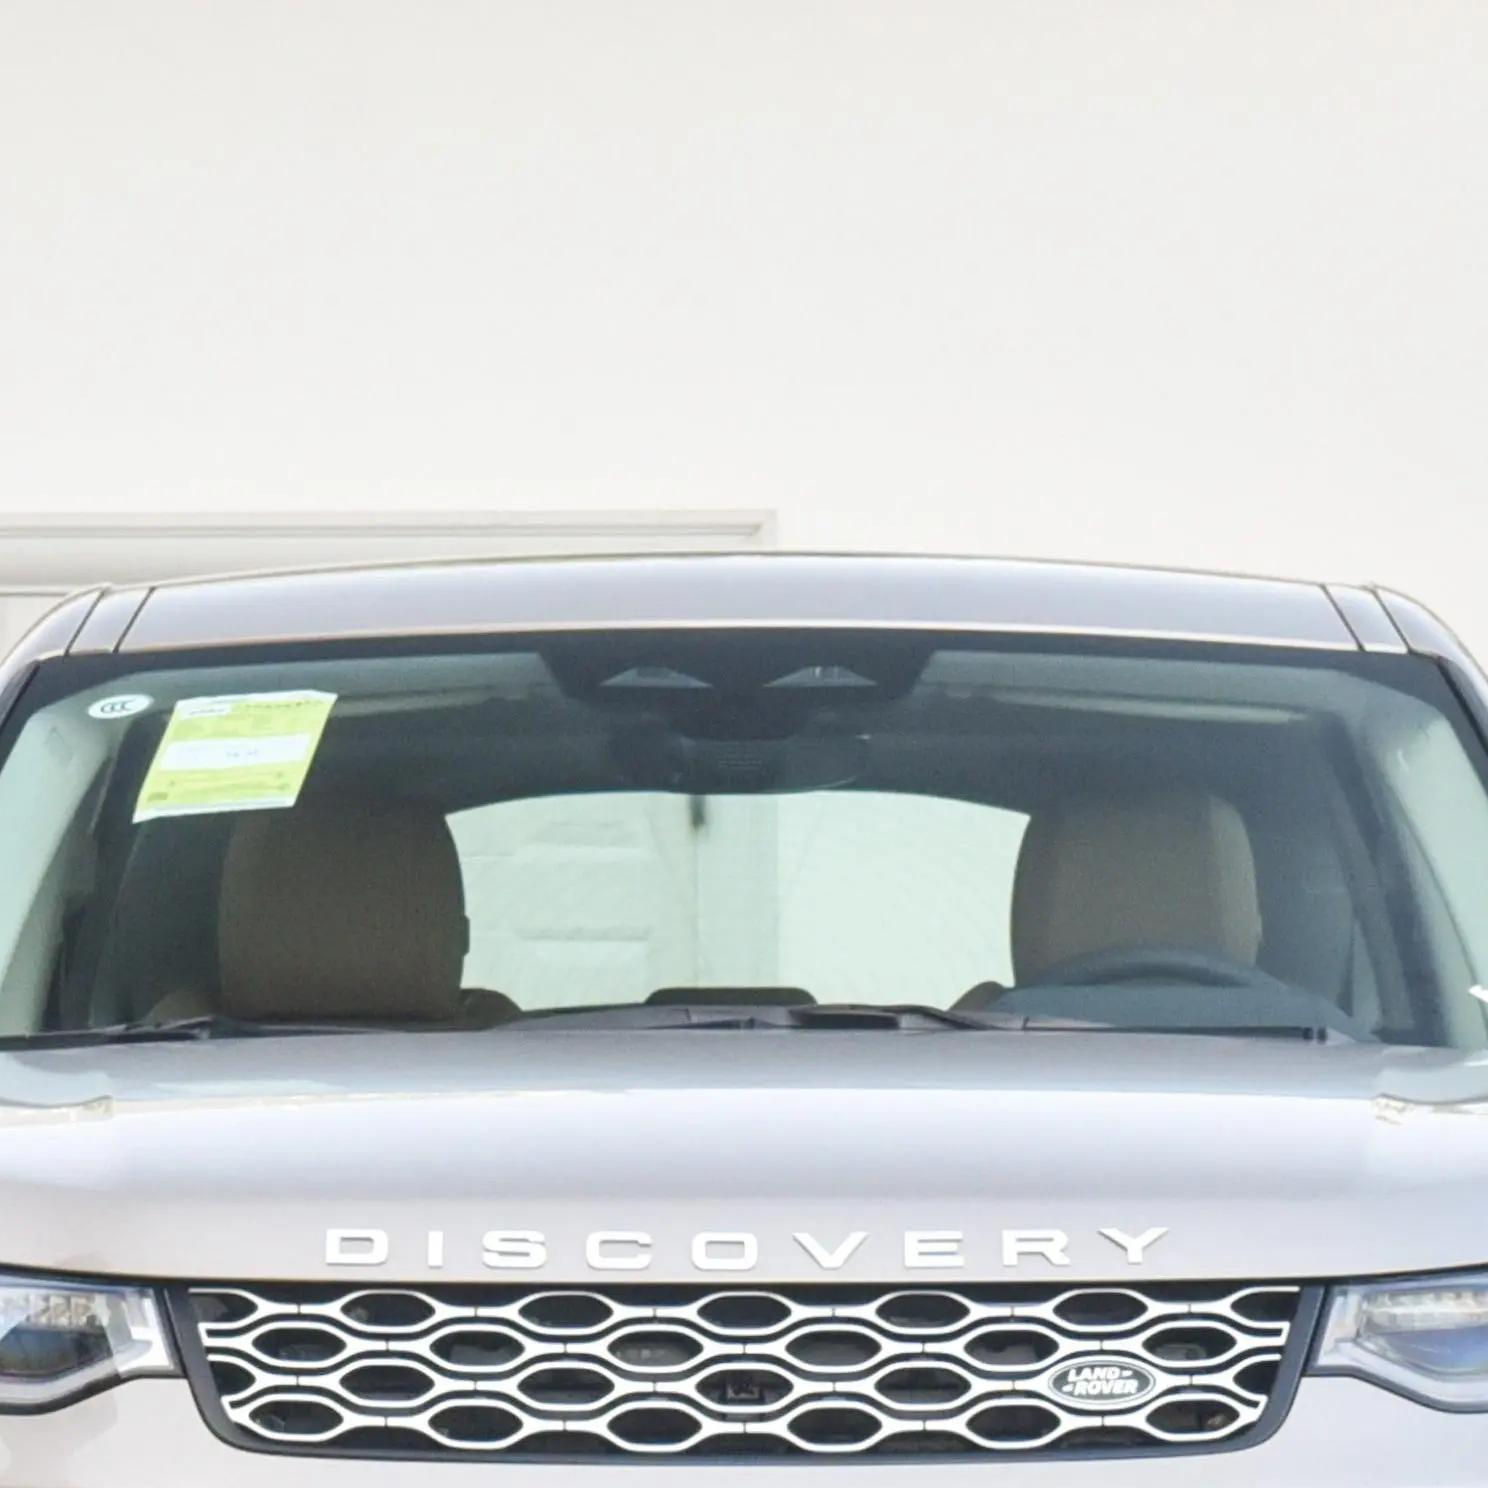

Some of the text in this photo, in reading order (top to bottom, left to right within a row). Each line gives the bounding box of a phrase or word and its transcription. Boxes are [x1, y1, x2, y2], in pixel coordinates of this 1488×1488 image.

[324, 1227, 1169, 1271] DISCOVERY
[1067, 1366, 1121, 1382] LAND
[1073, 1379, 1139, 1396] ROVER
